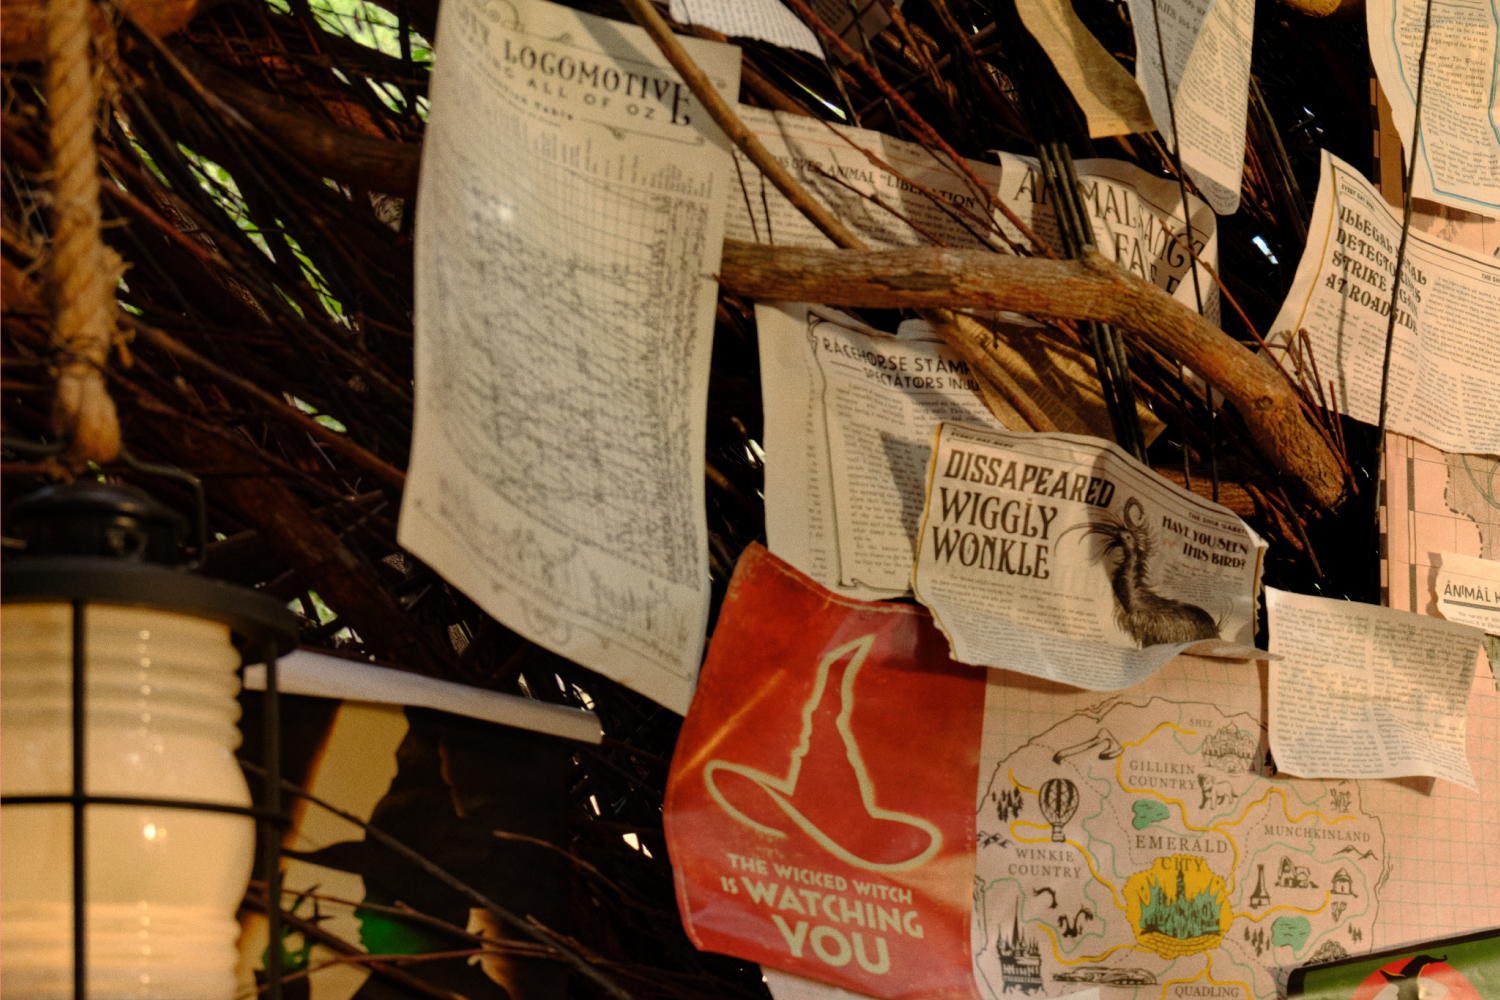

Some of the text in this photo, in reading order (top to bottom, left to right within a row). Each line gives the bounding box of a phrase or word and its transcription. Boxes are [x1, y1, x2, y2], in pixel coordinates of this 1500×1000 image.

[583, 92, 611, 109] OF
[626, 102, 656, 120] OZ
[828, 163, 876, 184] ANIMAL
[1340, 205, 1394, 255] ILLEGAL
[1332, 250, 1387, 292] STRIKE
[823, 336, 909, 372] RACEHORSE
[863, 366, 945, 390] SPECTATORS
[944, 449, 1116, 510] DISSAPEARED
[940, 486, 1058, 541] WIGGLY
[1162, 515, 1249, 556] HAVE YOU SEEN
[932, 525, 1051, 580] WONKLE
[1183, 542, 1247, 571] THIS BIRD?
[1443, 580, 1492, 604] ANIMAL
[1128, 759, 1196, 776] GILLIKIN
[1128, 774, 1197, 791] COUNTRY
[1135, 834, 1228, 855] EMERALD
[1263, 823, 1371, 843] MUNCHKINLAND
[1015, 847, 1075, 863] WINKIE
[1160, 856, 1205, 873] CITY
[726, 852, 913, 905] THE WICKED WITCH
[1007, 863, 1083, 879] COUNTRY
[720, 876, 925, 939] IS WATCHING
[771, 913, 891, 976] YOU
[1174, 985, 1240, 1000] QUADLING
